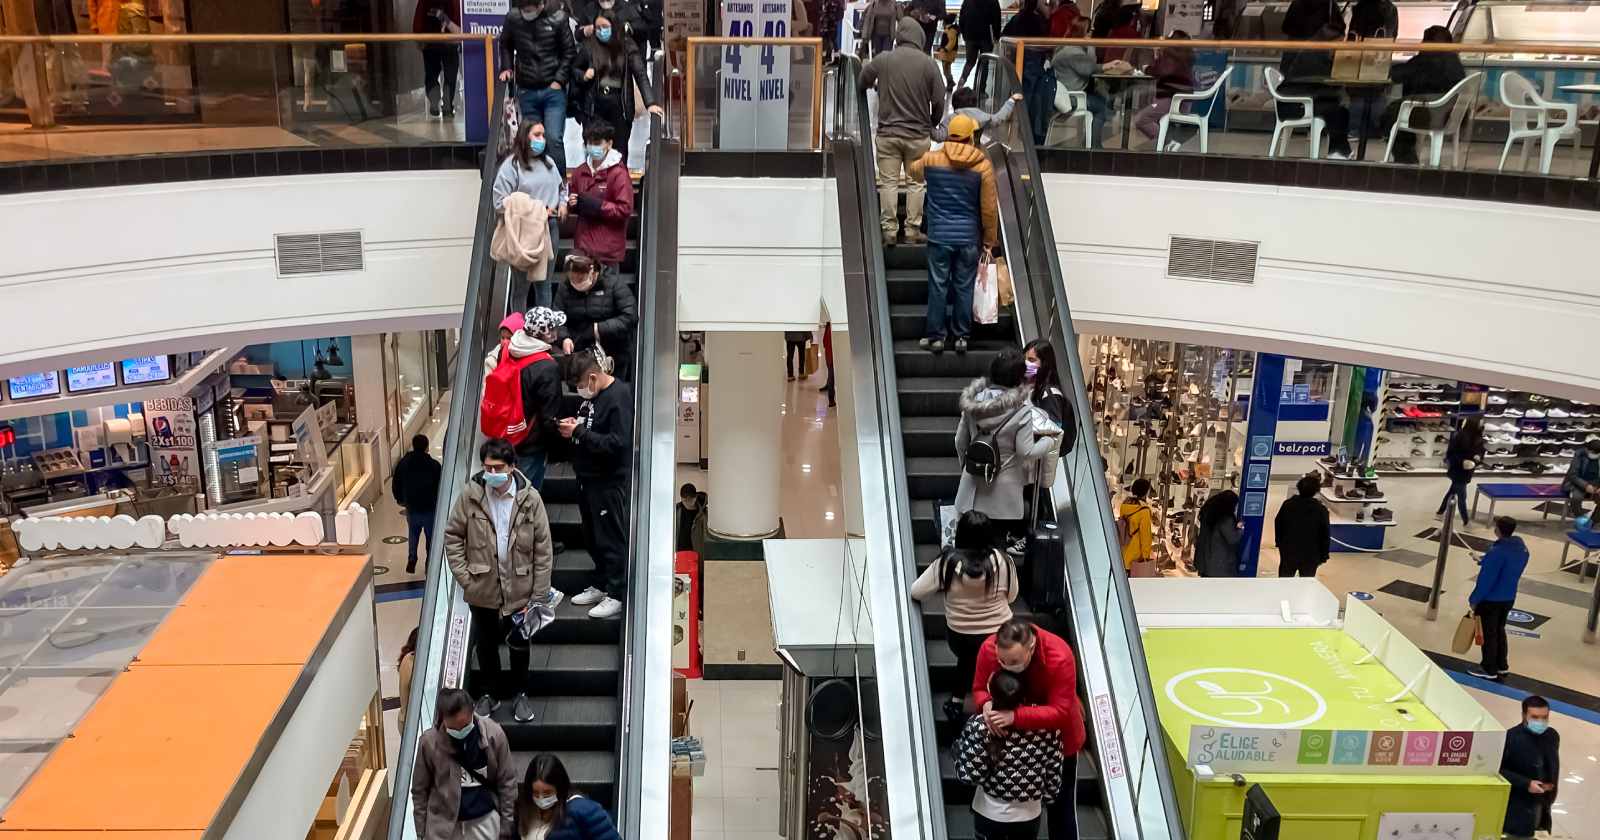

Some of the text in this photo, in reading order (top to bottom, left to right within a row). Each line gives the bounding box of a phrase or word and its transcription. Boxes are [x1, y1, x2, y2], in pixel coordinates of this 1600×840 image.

[727, 3, 753, 13] ARTESANOS
[762, 3, 786, 13] ARTESANOS
[724, 77, 752, 101] NIVEL
[760, 78, 785, 101] NIVEL
[146, 397, 193, 412] BEBIDAS
[1278, 443, 1327, 455] belsport
[1198, 741, 1278, 764] SALUDABLE
